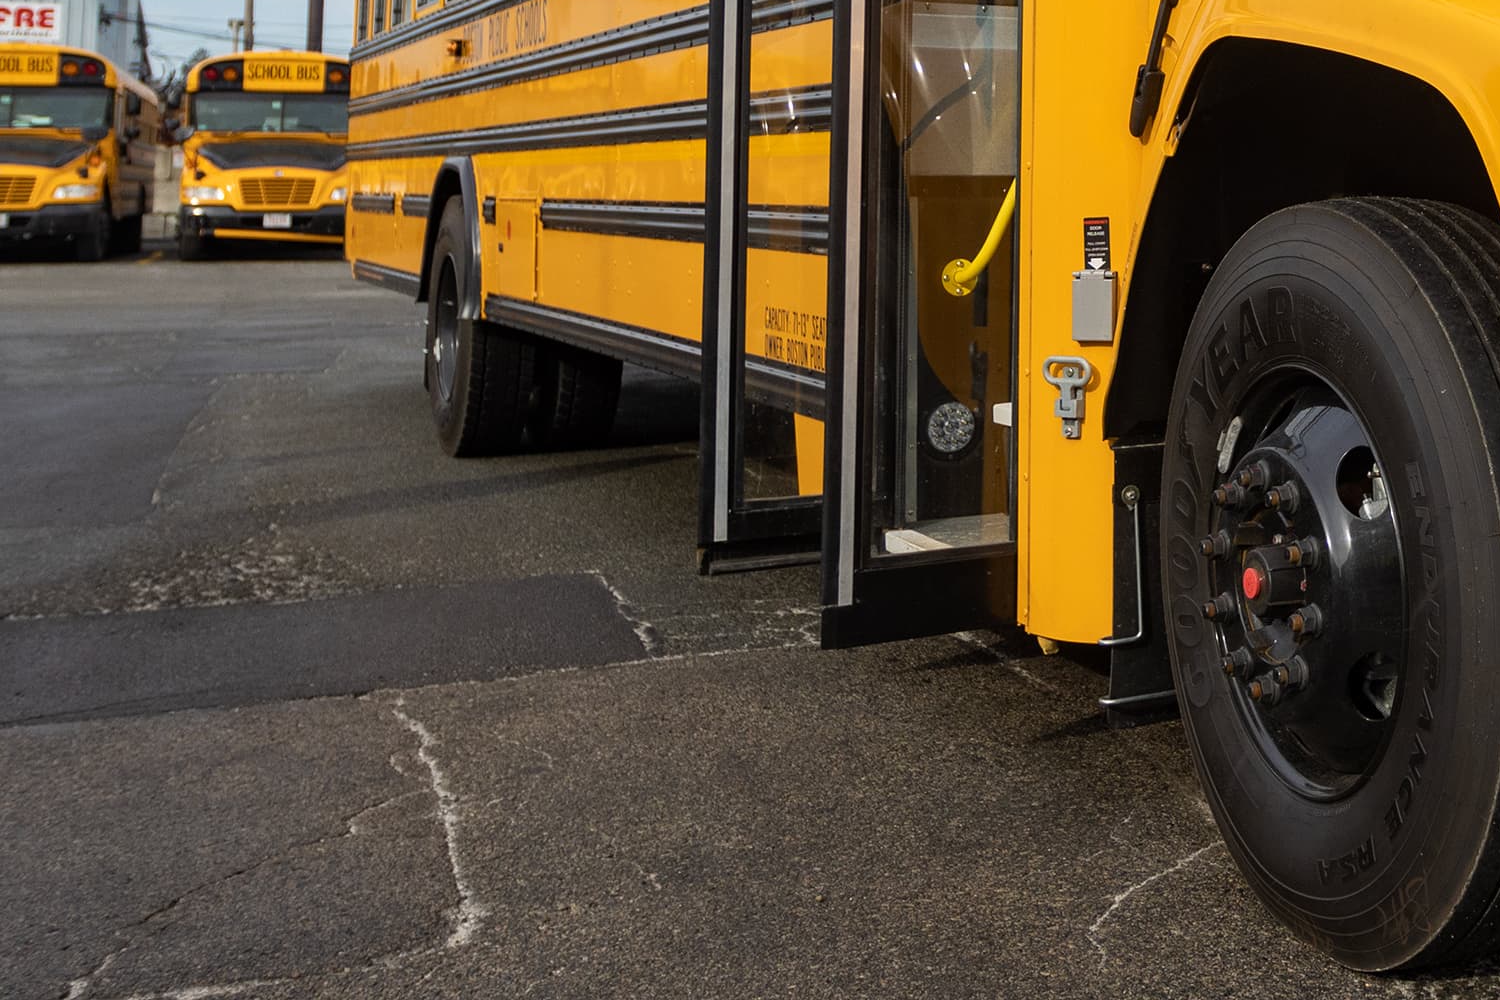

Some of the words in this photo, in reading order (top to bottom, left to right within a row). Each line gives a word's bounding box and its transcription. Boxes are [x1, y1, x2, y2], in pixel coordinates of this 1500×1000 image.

[28, 56, 53, 73] BUS
[248, 64, 291, 80] SCHOOL
[297, 64, 320, 80] BUS
[787, 338, 808, 366] BOSTON
